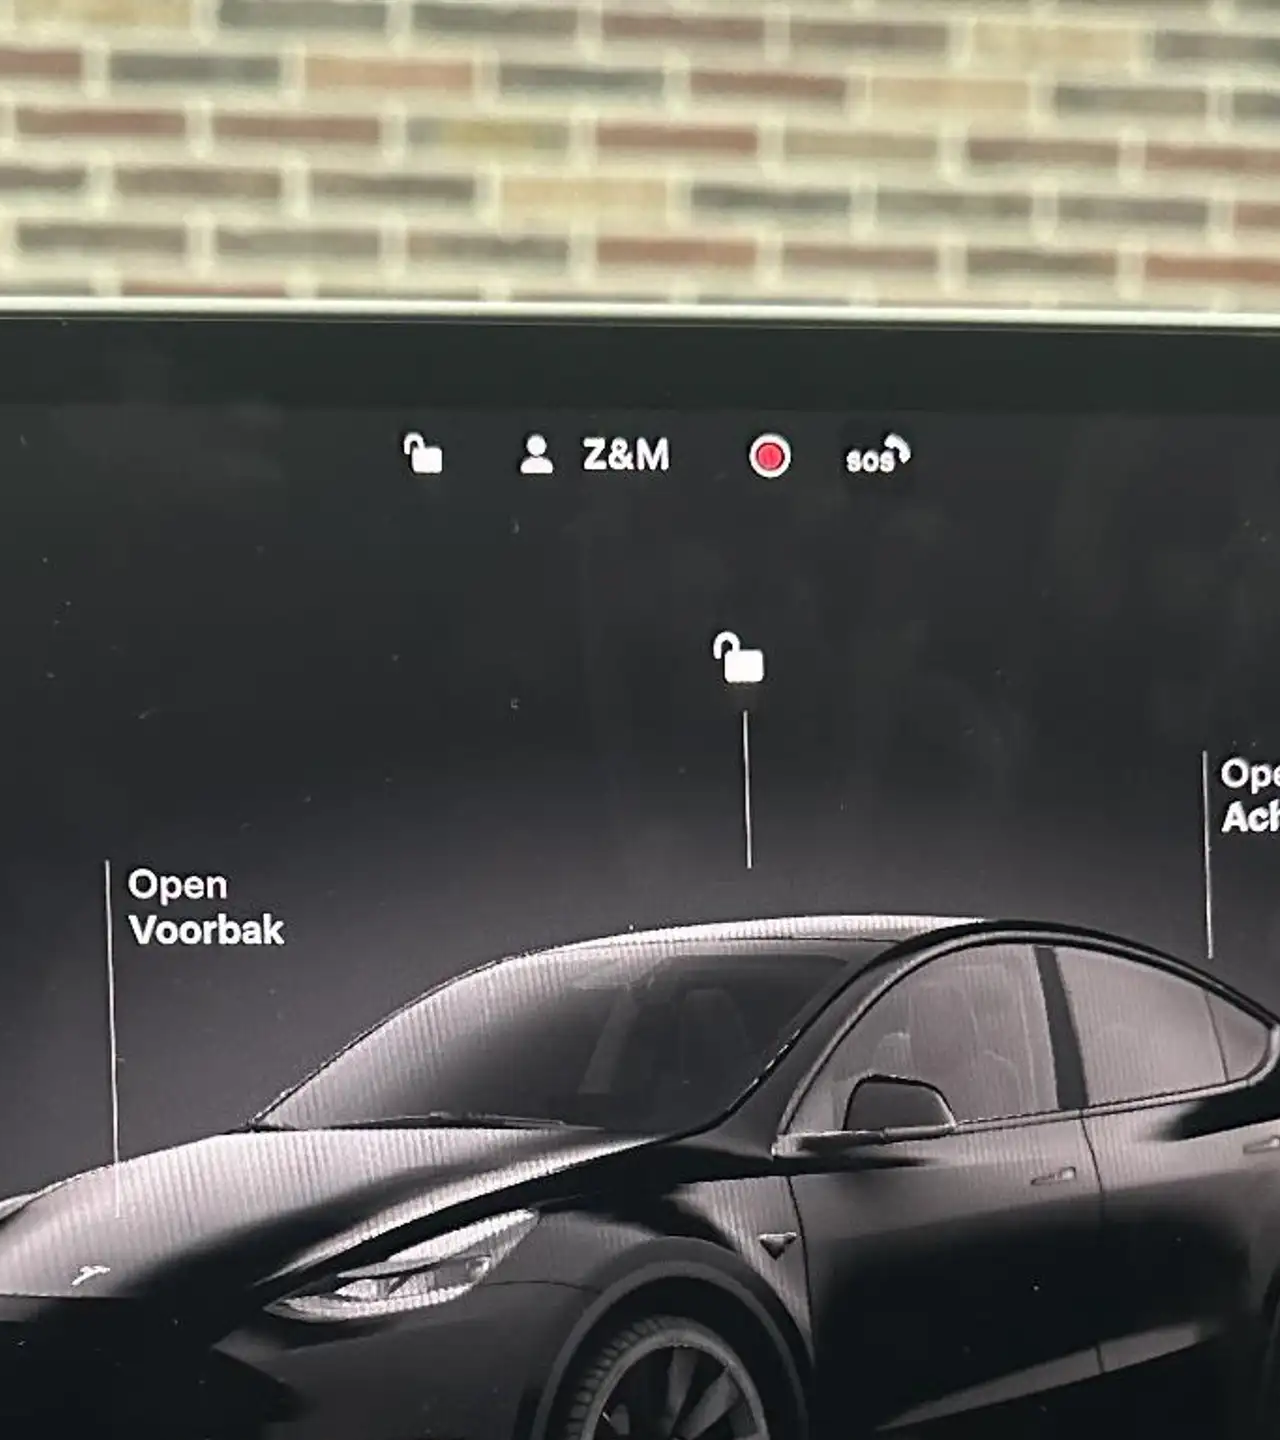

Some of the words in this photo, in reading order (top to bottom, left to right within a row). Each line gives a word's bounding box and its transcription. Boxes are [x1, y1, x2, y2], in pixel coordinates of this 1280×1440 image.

[583, 437, 670, 471] Z&M
[128, 868, 227, 907] Open
[128, 912, 285, 945] Voorbak
